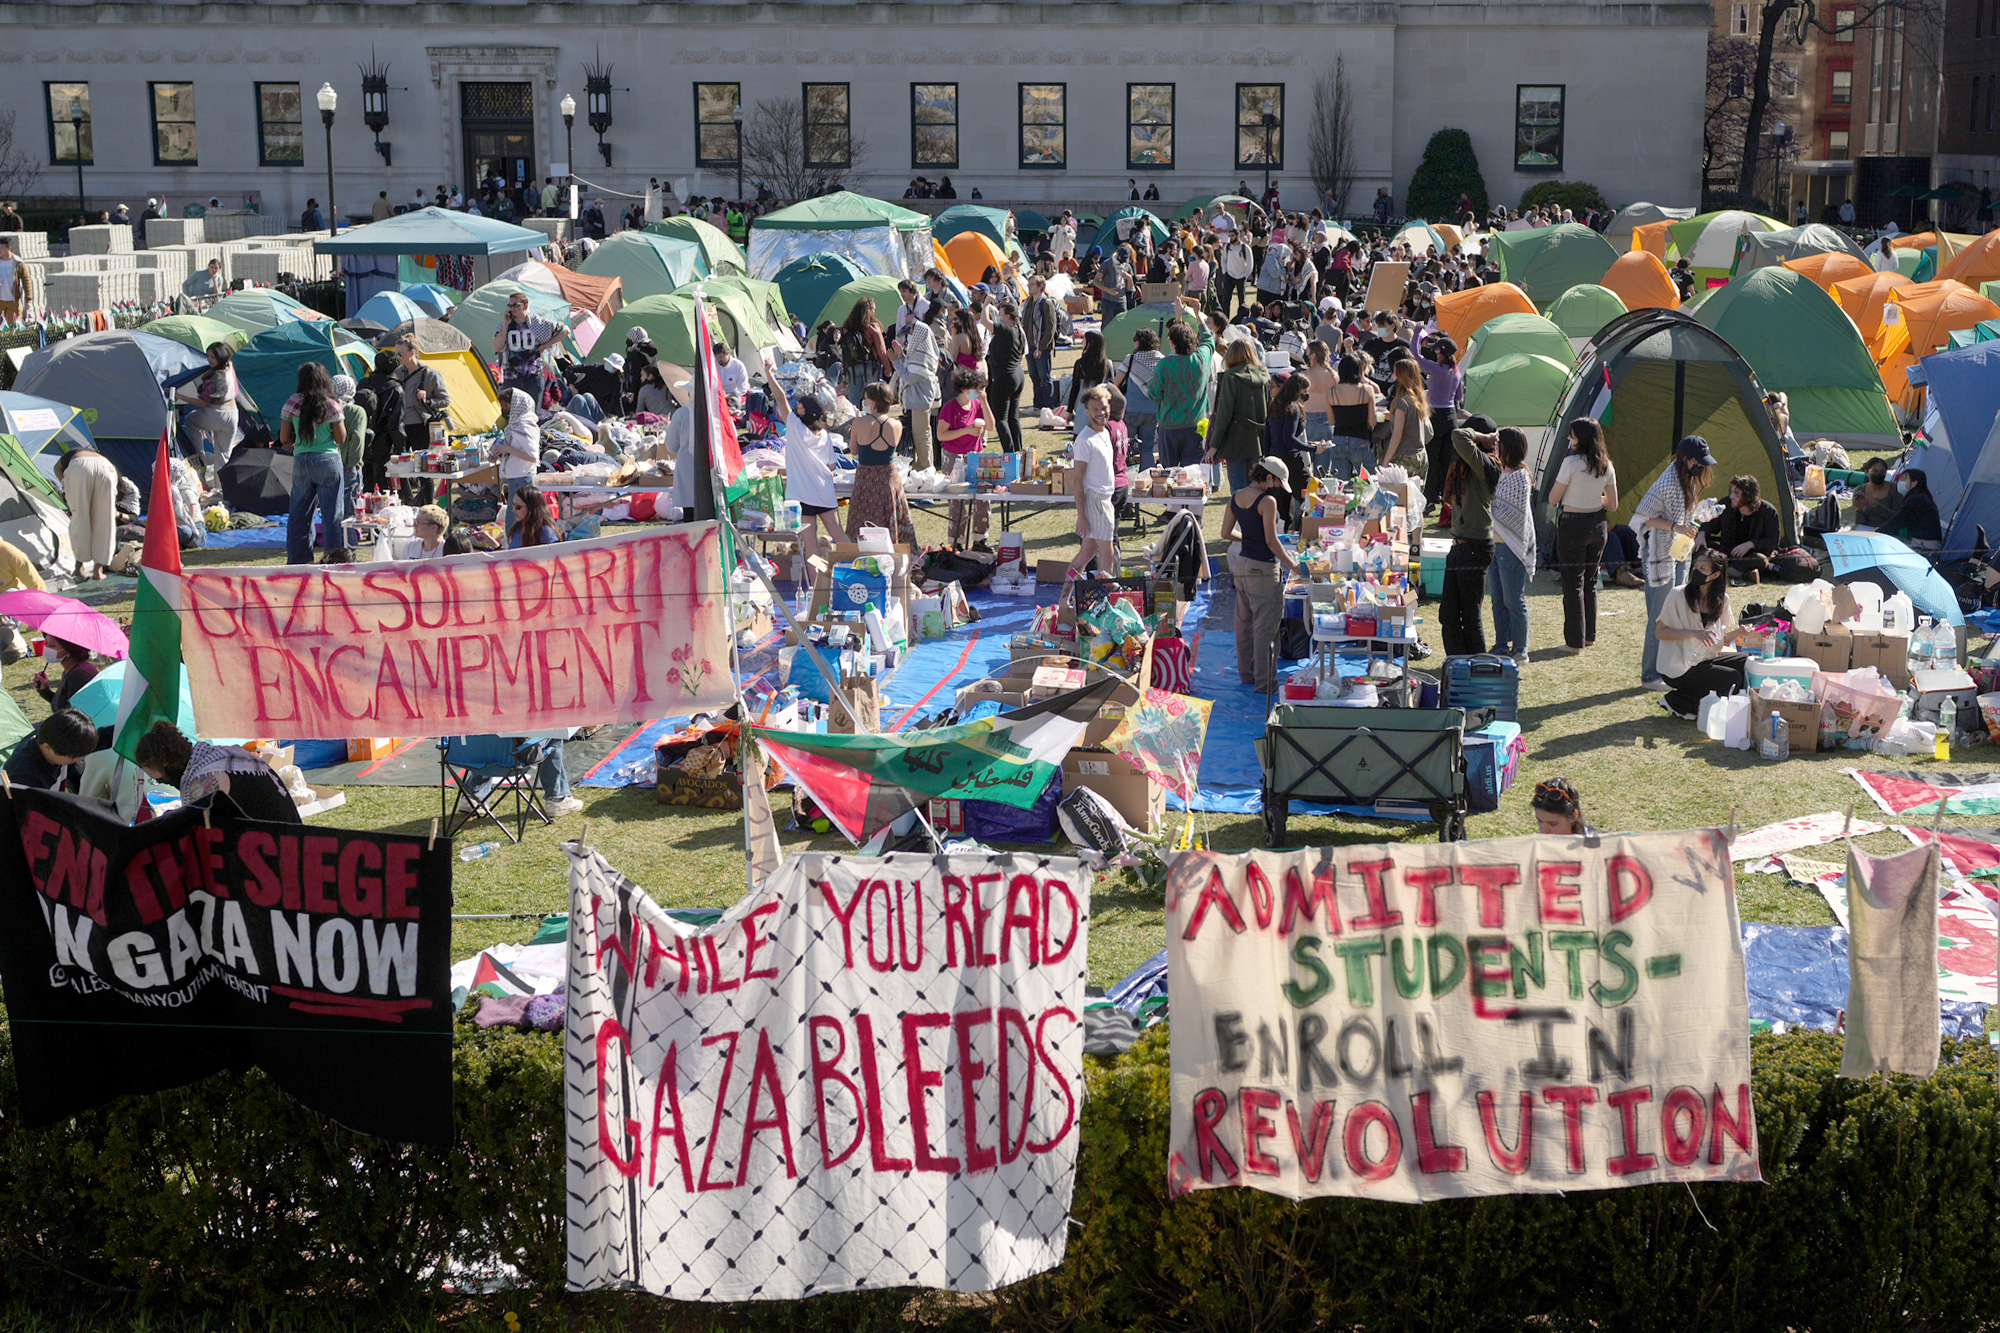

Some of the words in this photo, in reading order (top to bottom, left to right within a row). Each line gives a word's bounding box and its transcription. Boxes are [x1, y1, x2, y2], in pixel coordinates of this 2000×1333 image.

[508, 329, 536, 351] 00
[185, 570, 373, 638] GAZA
[364, 526, 718, 631] SOLIDARITY
[242, 621, 660, 723] ENCAMPMENT
[676, 777, 729, 790] AVOCADOS
[1073, 802, 1110, 851] HomeGoods
[1484, 764, 1494, 795] aldi.us
[124, 825, 230, 925] THE
[238, 831, 421, 919] SIEGE
[1182, 853, 1655, 942] ADMITTED
[106, 890, 260, 989] GAZA
[270, 909, 419, 997] NOW
[590, 896, 780, 996] WHILE
[818, 878, 924, 972] YOU
[942, 871, 1080, 969] READ
[1215, 1009, 1463, 1091] ENROLL
[1505, 1006, 1635, 1083] IN
[596, 1017, 798, 1194] GAZA
[810, 1005, 1078, 1176] BLEEDS
[1190, 1082, 1754, 1185] REVOLUTION
